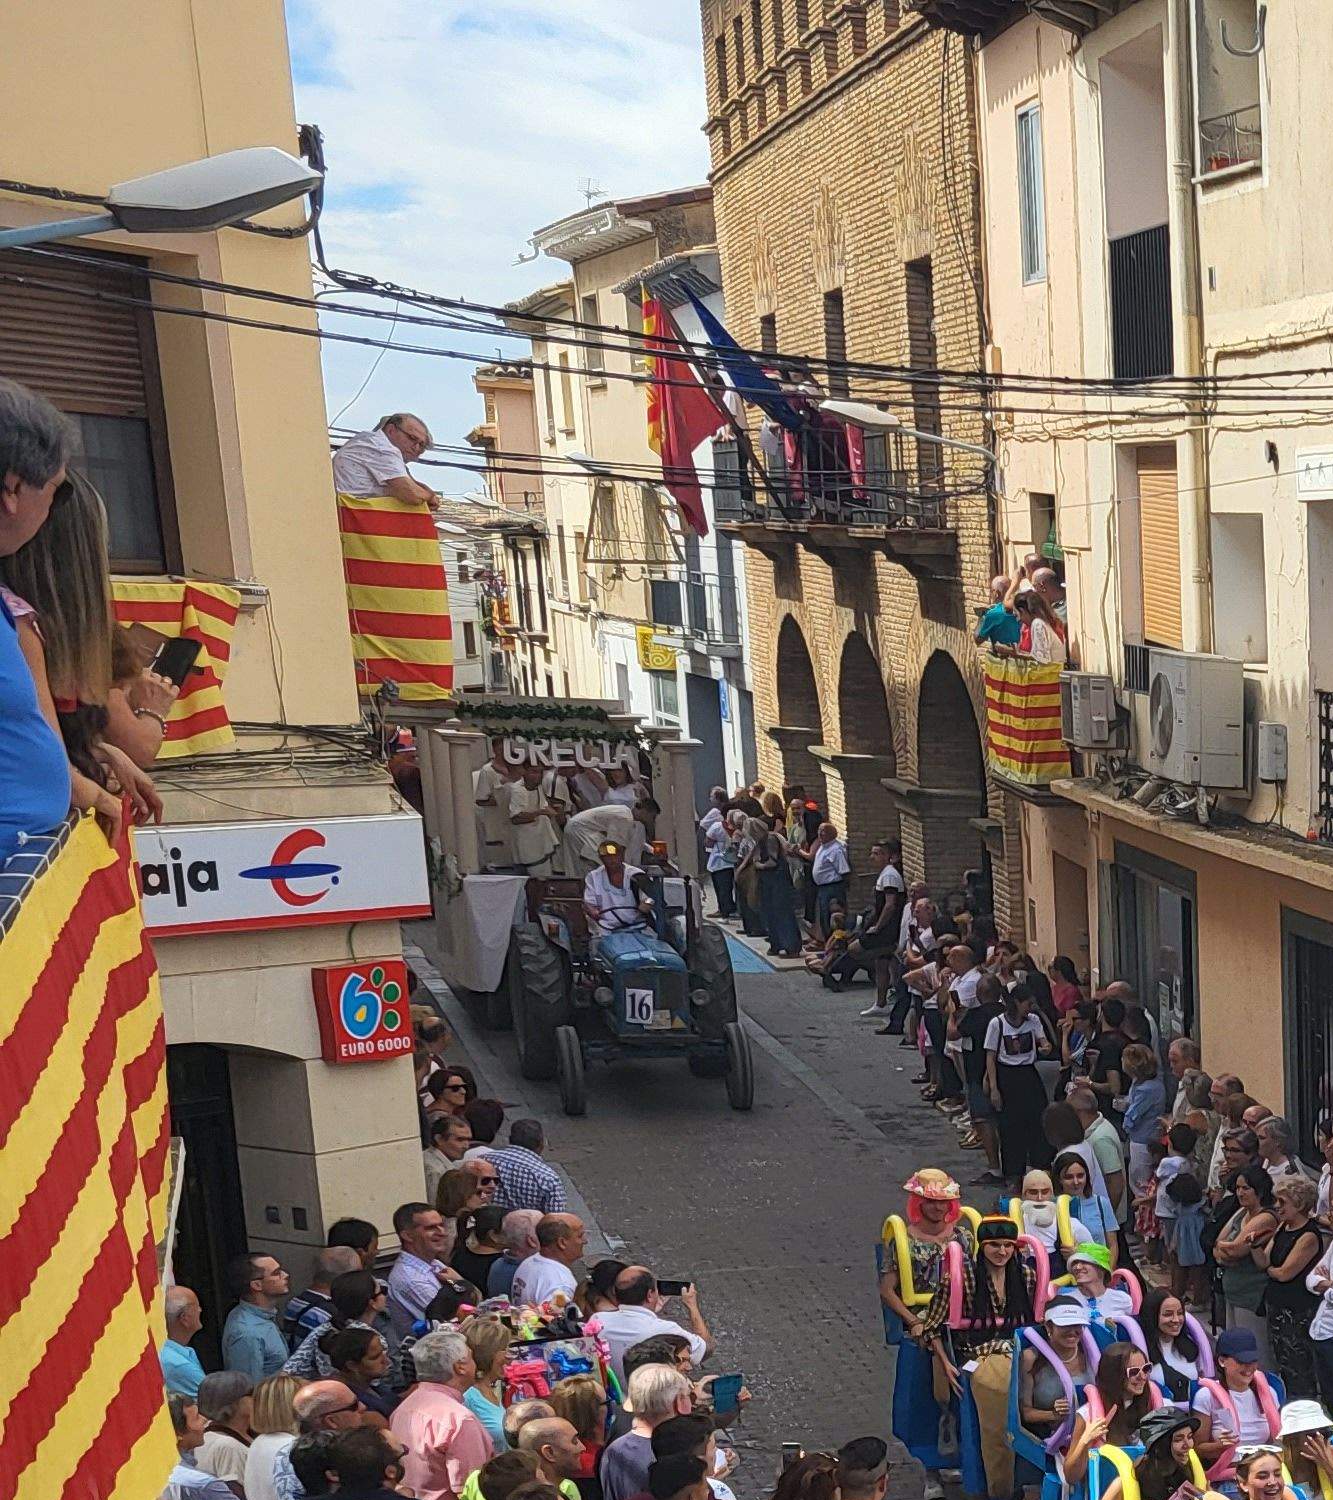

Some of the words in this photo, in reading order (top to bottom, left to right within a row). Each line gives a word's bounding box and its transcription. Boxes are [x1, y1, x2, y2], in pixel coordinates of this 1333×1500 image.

[503, 736, 640, 779] GRECIA
[140, 847, 219, 907] aja
[628, 992, 651, 1020] 16
[341, 1041, 374, 1056] EURO
[377, 1036, 411, 1052] 6000
